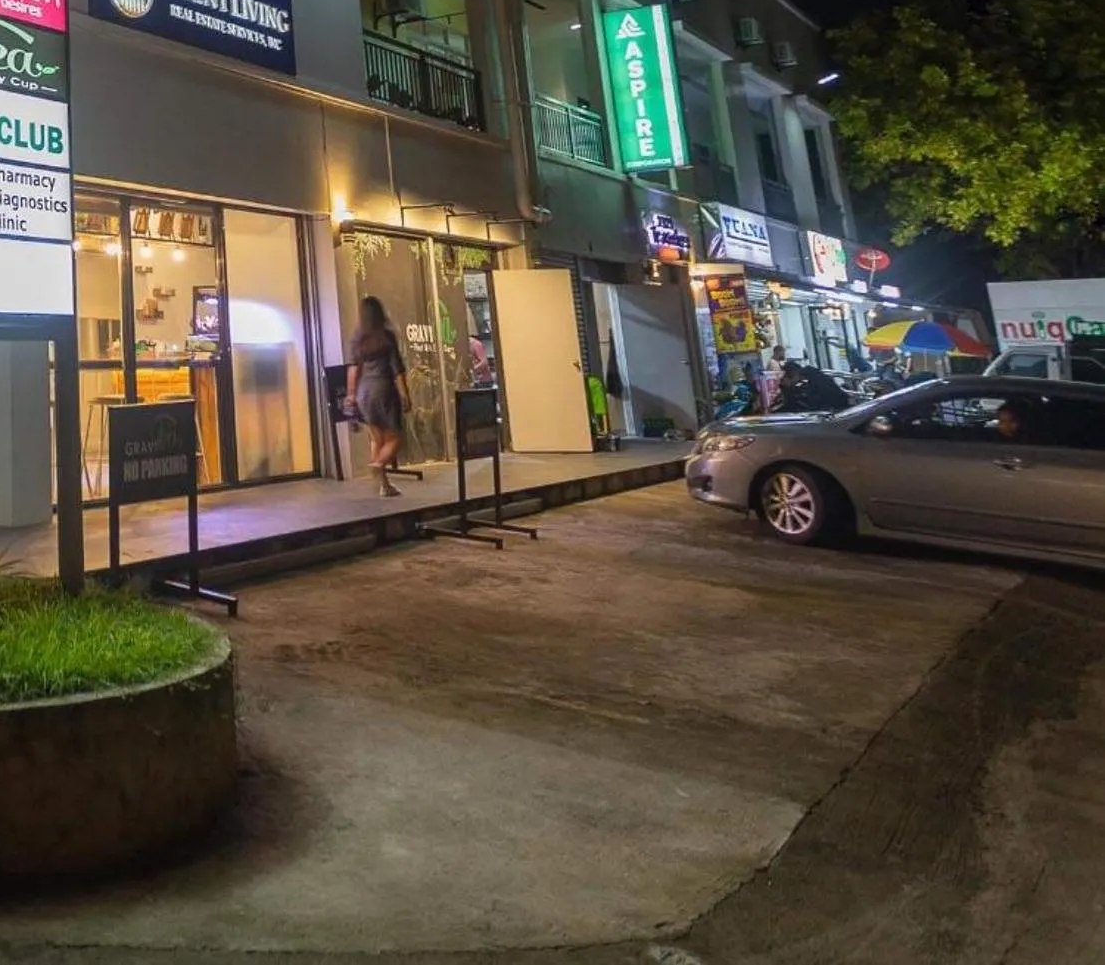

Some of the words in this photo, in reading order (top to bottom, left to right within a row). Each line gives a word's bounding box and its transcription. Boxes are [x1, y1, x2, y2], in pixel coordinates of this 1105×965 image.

[9, 75, 39, 92] Cup
[625, 40, 655, 157] ASPIRE
[123, 459, 138, 483] NO
[140, 454, 188, 480] PARKING
